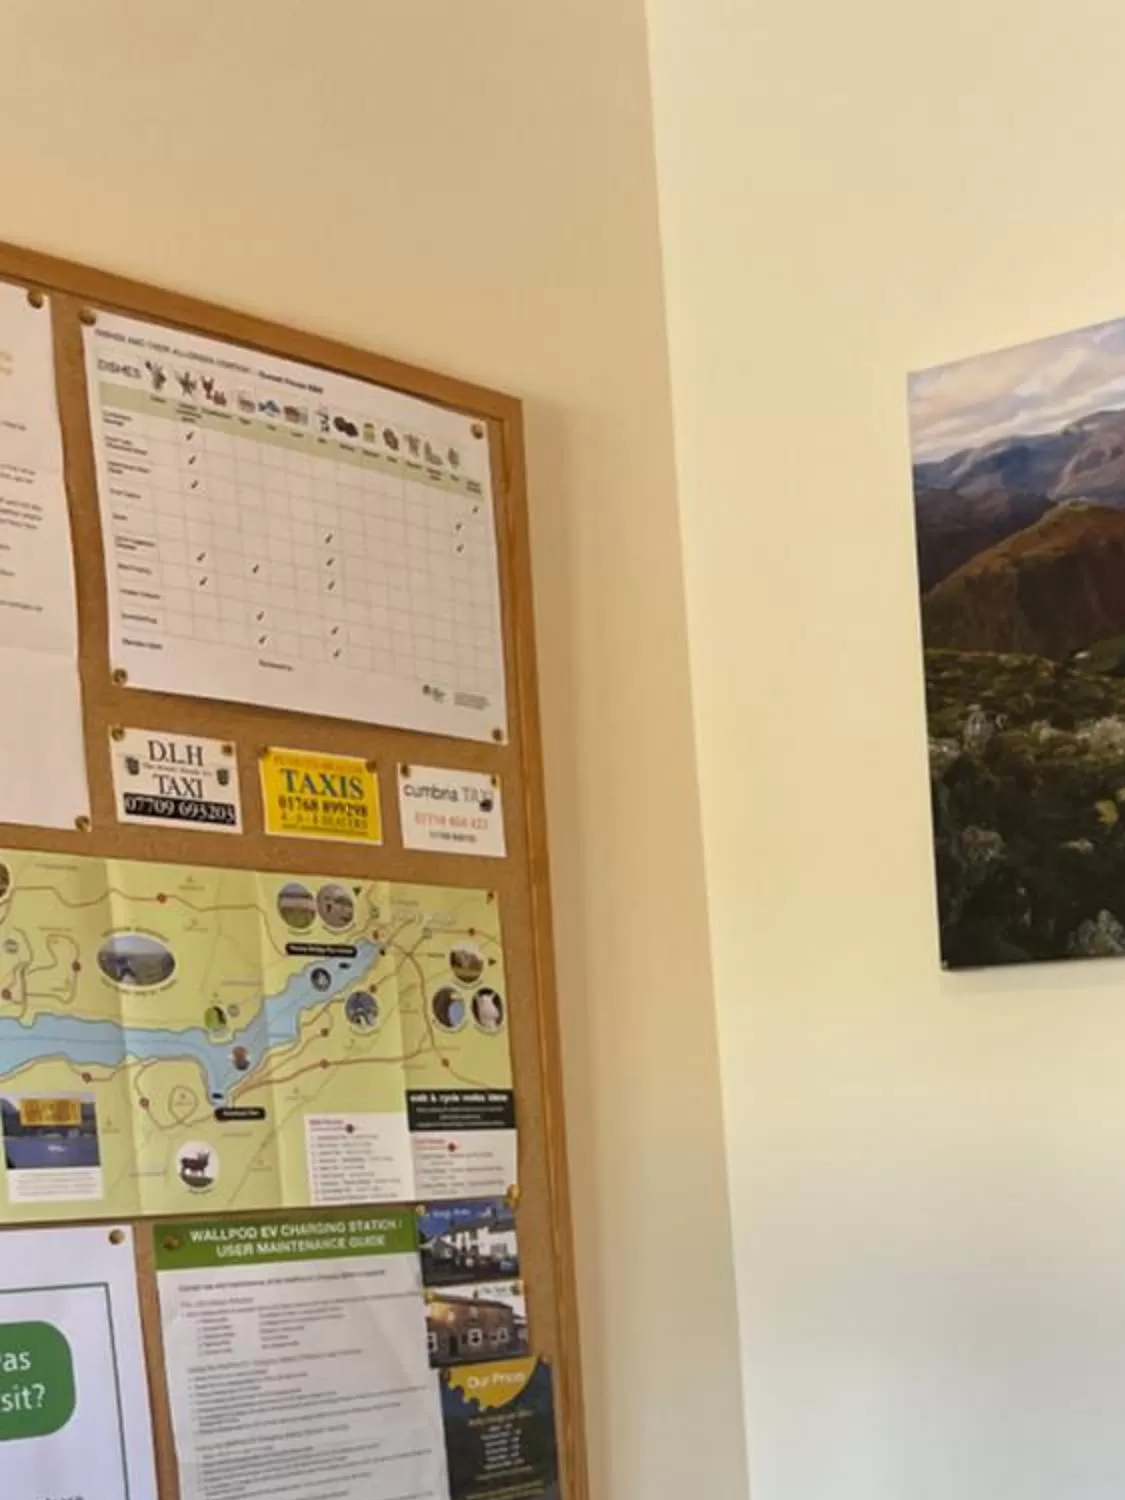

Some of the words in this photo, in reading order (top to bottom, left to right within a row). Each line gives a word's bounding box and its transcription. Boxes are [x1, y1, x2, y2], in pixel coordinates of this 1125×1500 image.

[147, 739, 204, 767] DLH
[152, 772, 204, 799] TAXI
[279, 767, 366, 801] TAXIS
[0, 1351, 32, 1373] as
